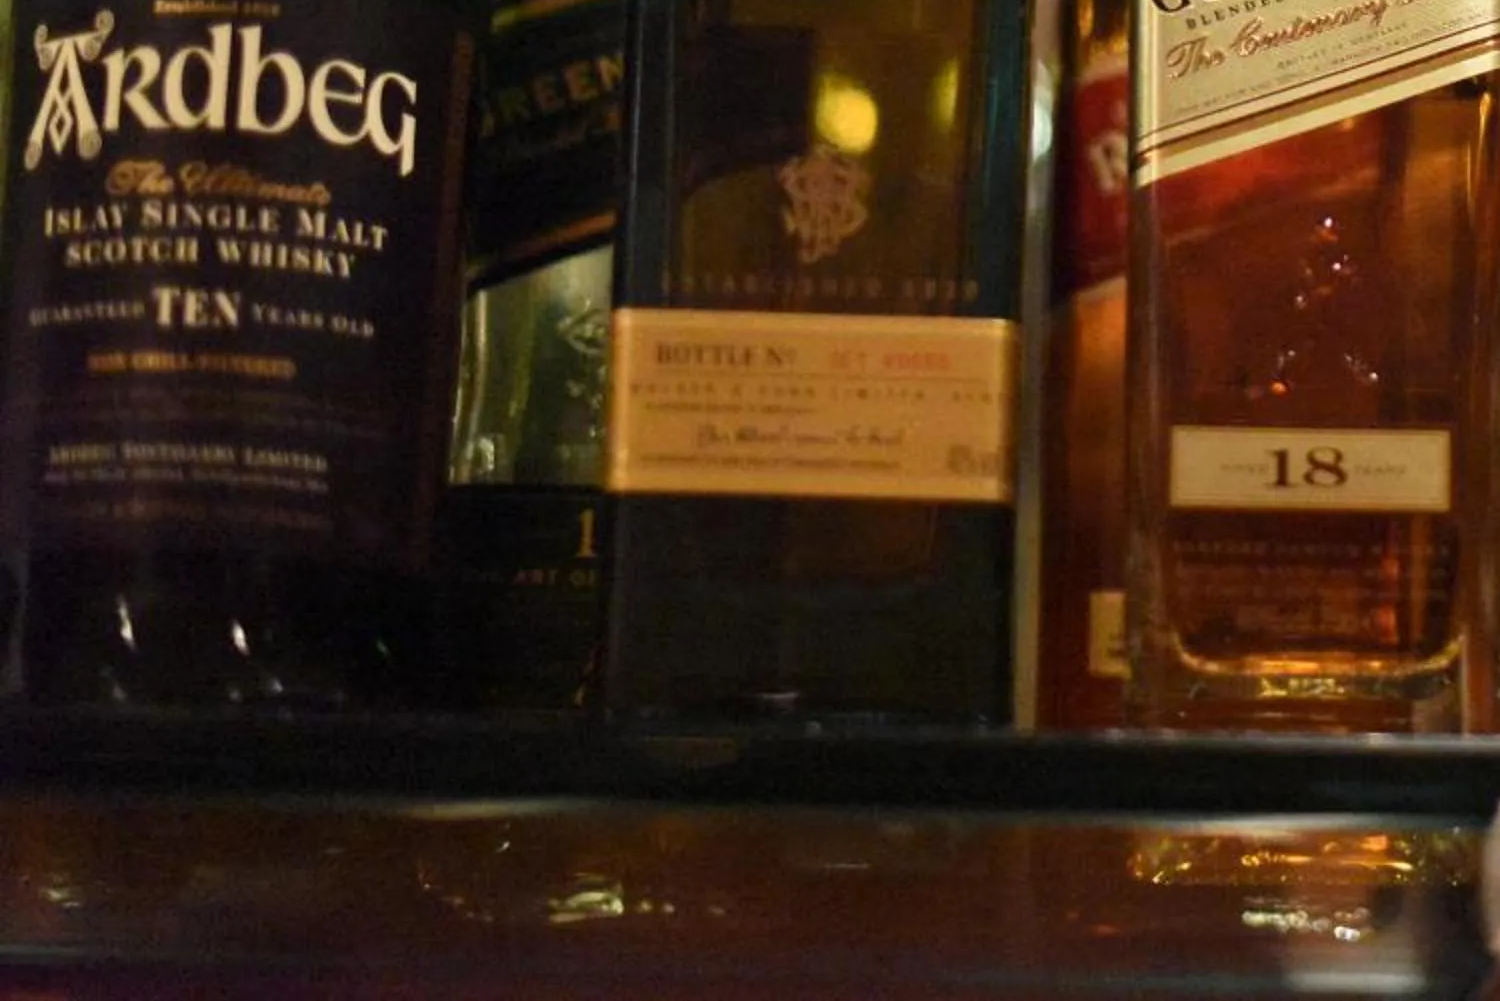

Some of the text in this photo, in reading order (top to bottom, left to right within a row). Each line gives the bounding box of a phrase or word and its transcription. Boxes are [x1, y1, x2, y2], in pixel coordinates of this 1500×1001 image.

[1165, 35, 1226, 81] The
[24, 10, 417, 176] Ardbeg
[44, 199, 388, 252] ISLAY SINGLE MALT
[65, 237, 357, 279] SCOTCH WHISKY
[151, 285, 242, 329] TEN
[252, 302, 324, 329] YEARS
[329, 314, 376, 339] OLD
[1263, 445, 1348, 489] 18
